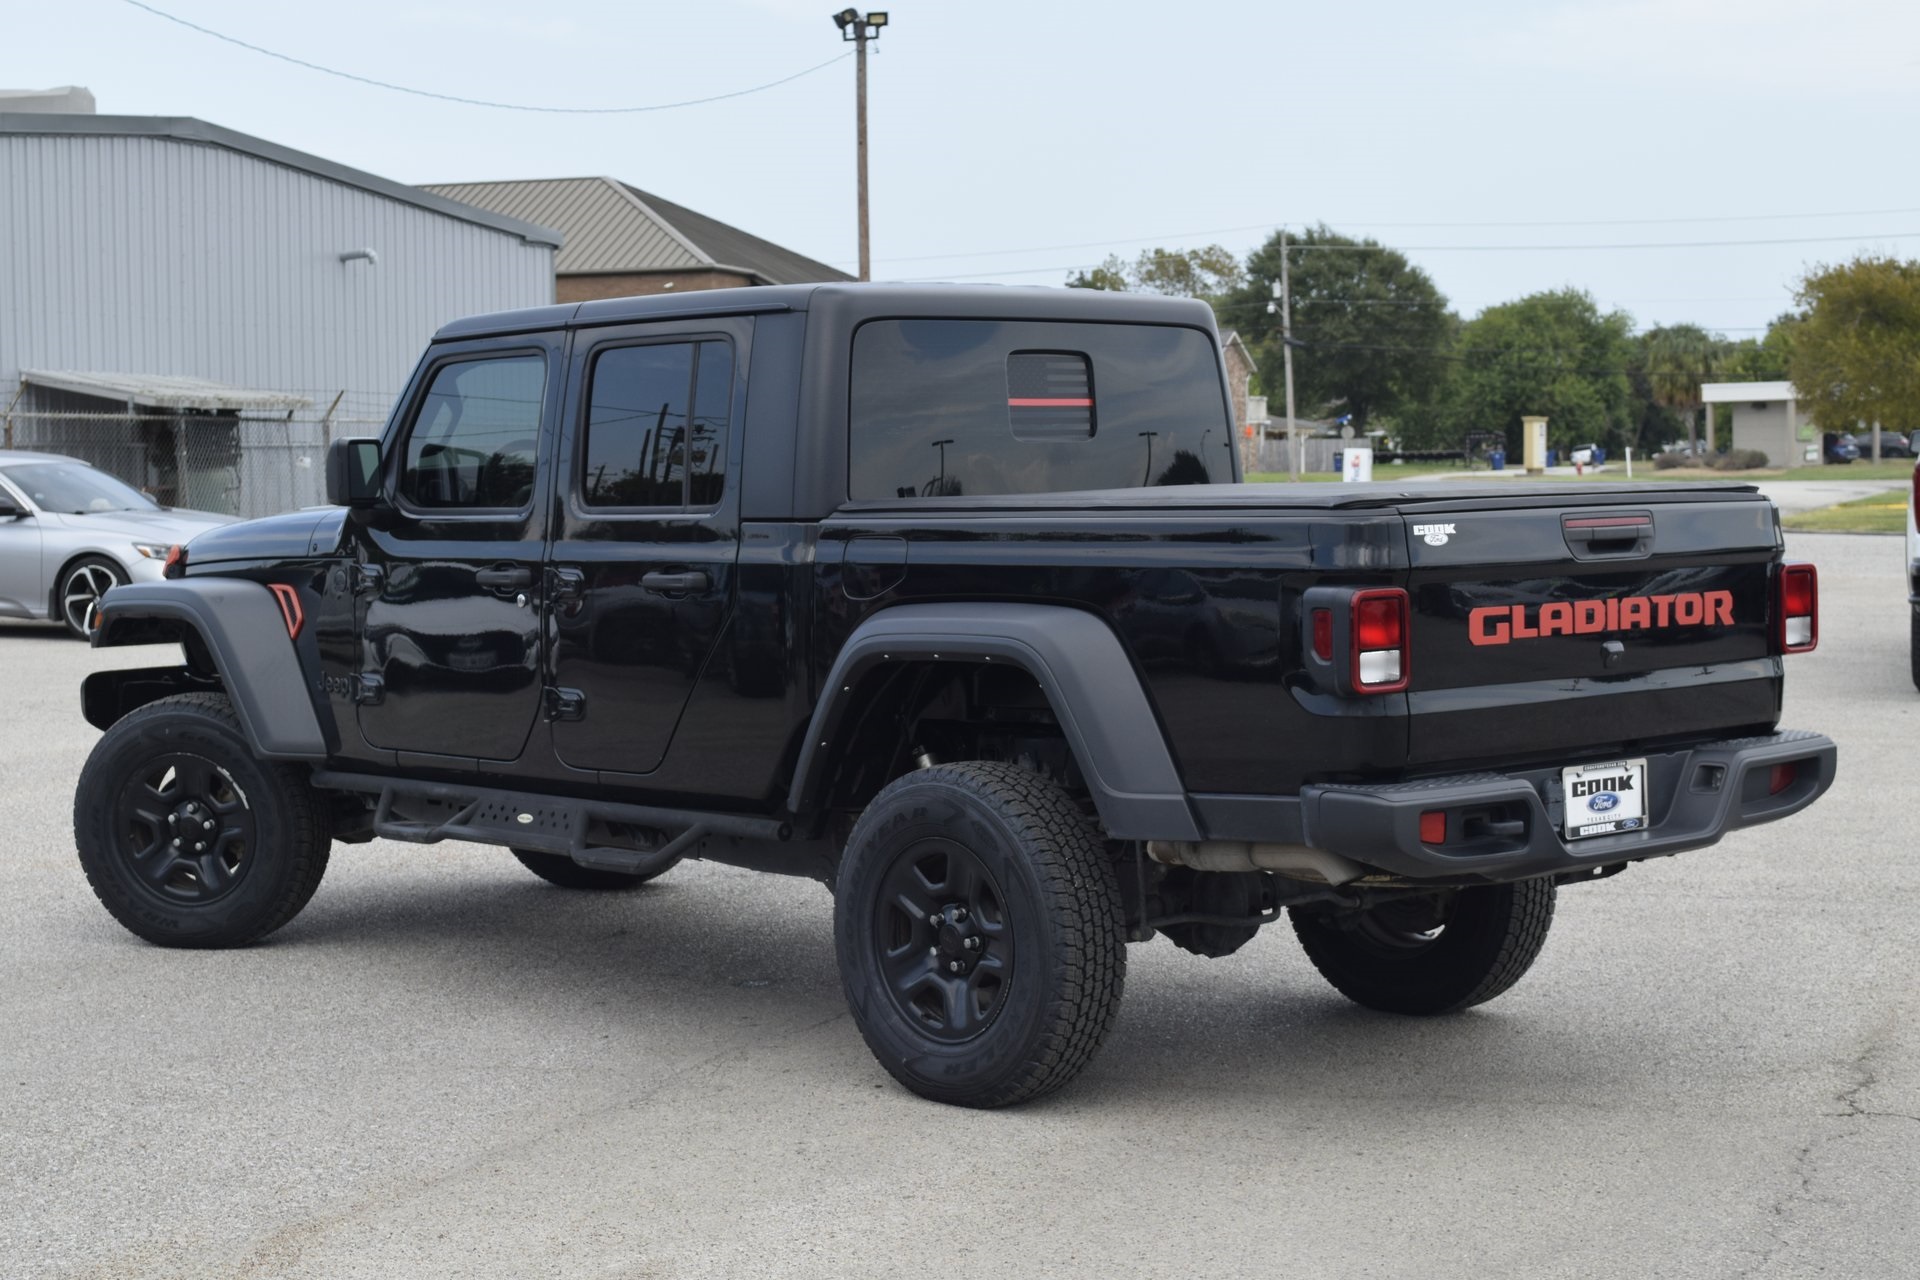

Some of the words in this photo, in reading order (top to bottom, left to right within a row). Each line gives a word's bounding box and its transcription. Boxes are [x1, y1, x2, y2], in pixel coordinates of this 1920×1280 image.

[1413, 523, 1457, 535] COOK
[1468, 590, 1735, 646] GLADIATOR
[316, 670, 350, 698] Jeep
[1572, 774, 1634, 797] COOK
[1593, 795, 1613, 810] Ford
[1580, 822, 1617, 836] COOK
[843, 805, 928, 971] GOODYEAR
